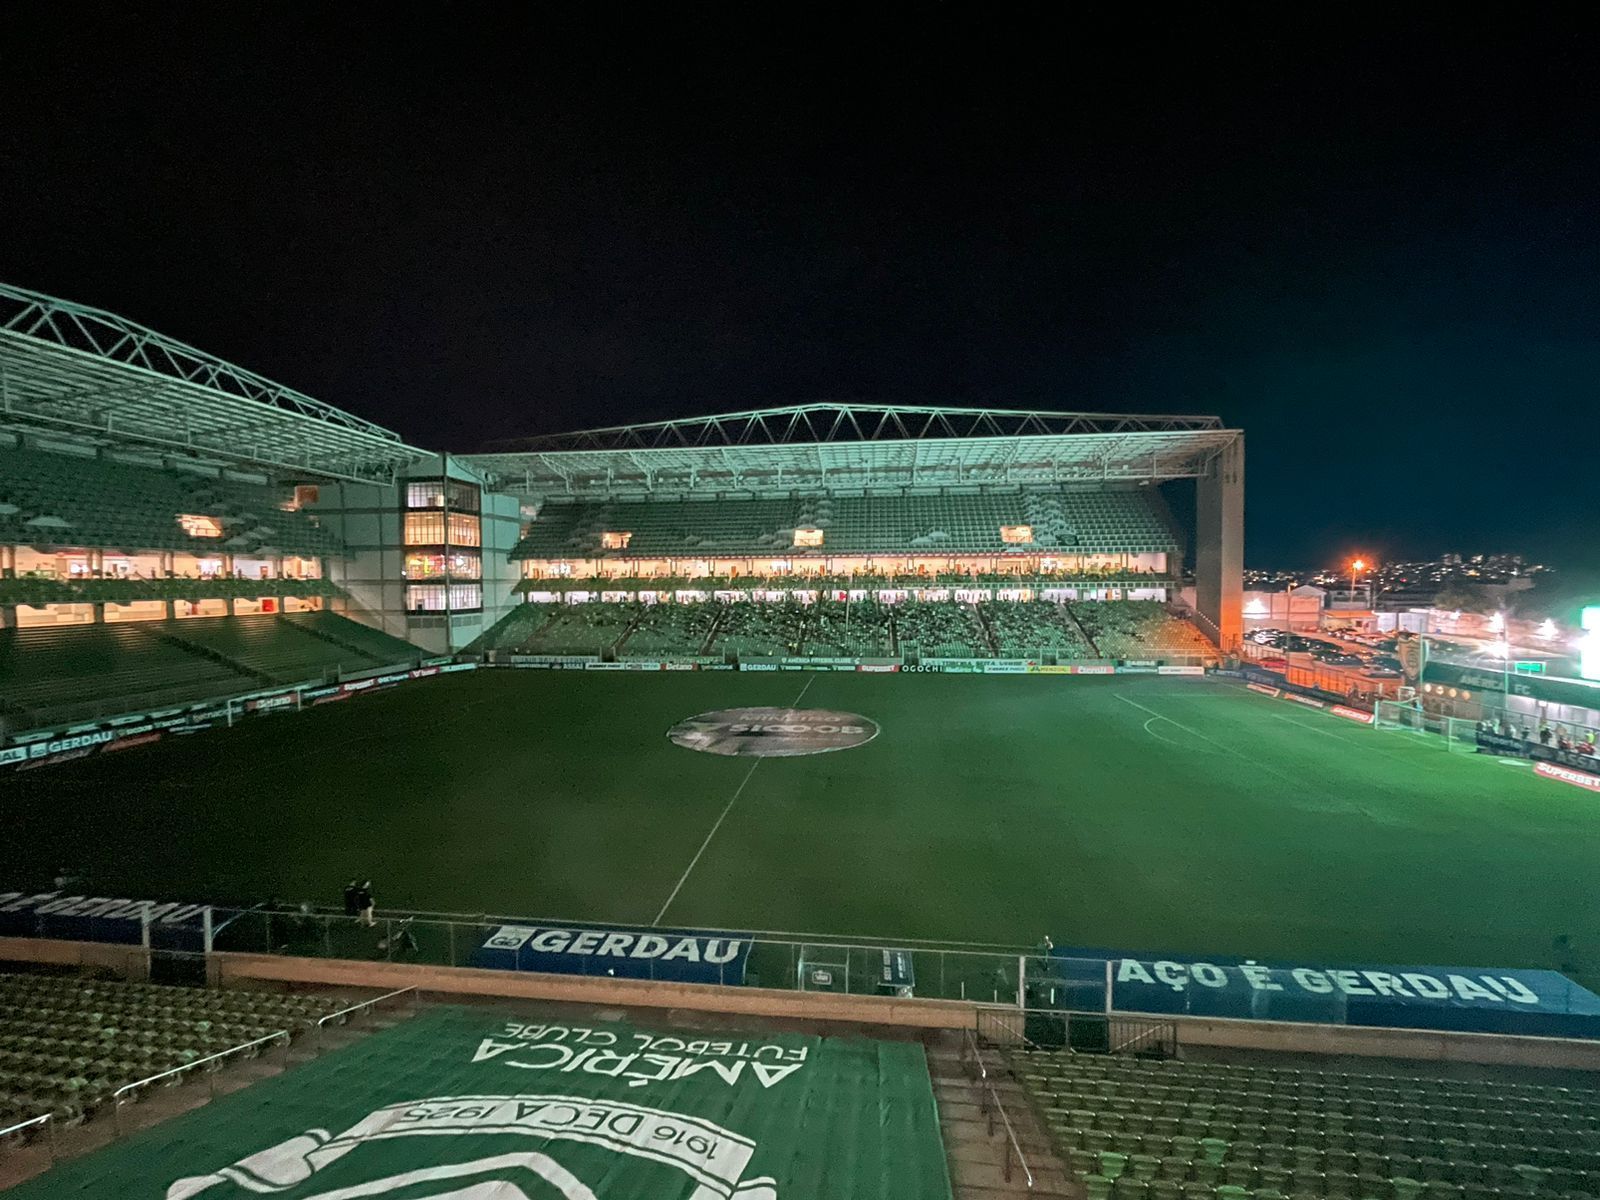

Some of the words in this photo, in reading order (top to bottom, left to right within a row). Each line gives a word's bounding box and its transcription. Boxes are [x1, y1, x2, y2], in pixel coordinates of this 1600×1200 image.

[902, 665, 943, 673] OGOCHI
[1514, 684, 1531, 694] FC
[49, 730, 113, 753] GERDAU
[34, 896, 210, 924] GERDAU
[530, 930, 741, 964] GERDAU
[1117, 958, 1228, 991] AÇO
[1239, 960, 1284, 991] É
[1292, 968, 1539, 1004] GERDAU
[504, 1023, 617, 1044] CLUBE
[634, 1034, 808, 1061] FUTEBOL
[471, 1038, 804, 1088] AMÉRICA
[401, 1104, 496, 1124] 1925
[515, 1102, 645, 1136] DECA
[652, 1125, 719, 1160] 1916
